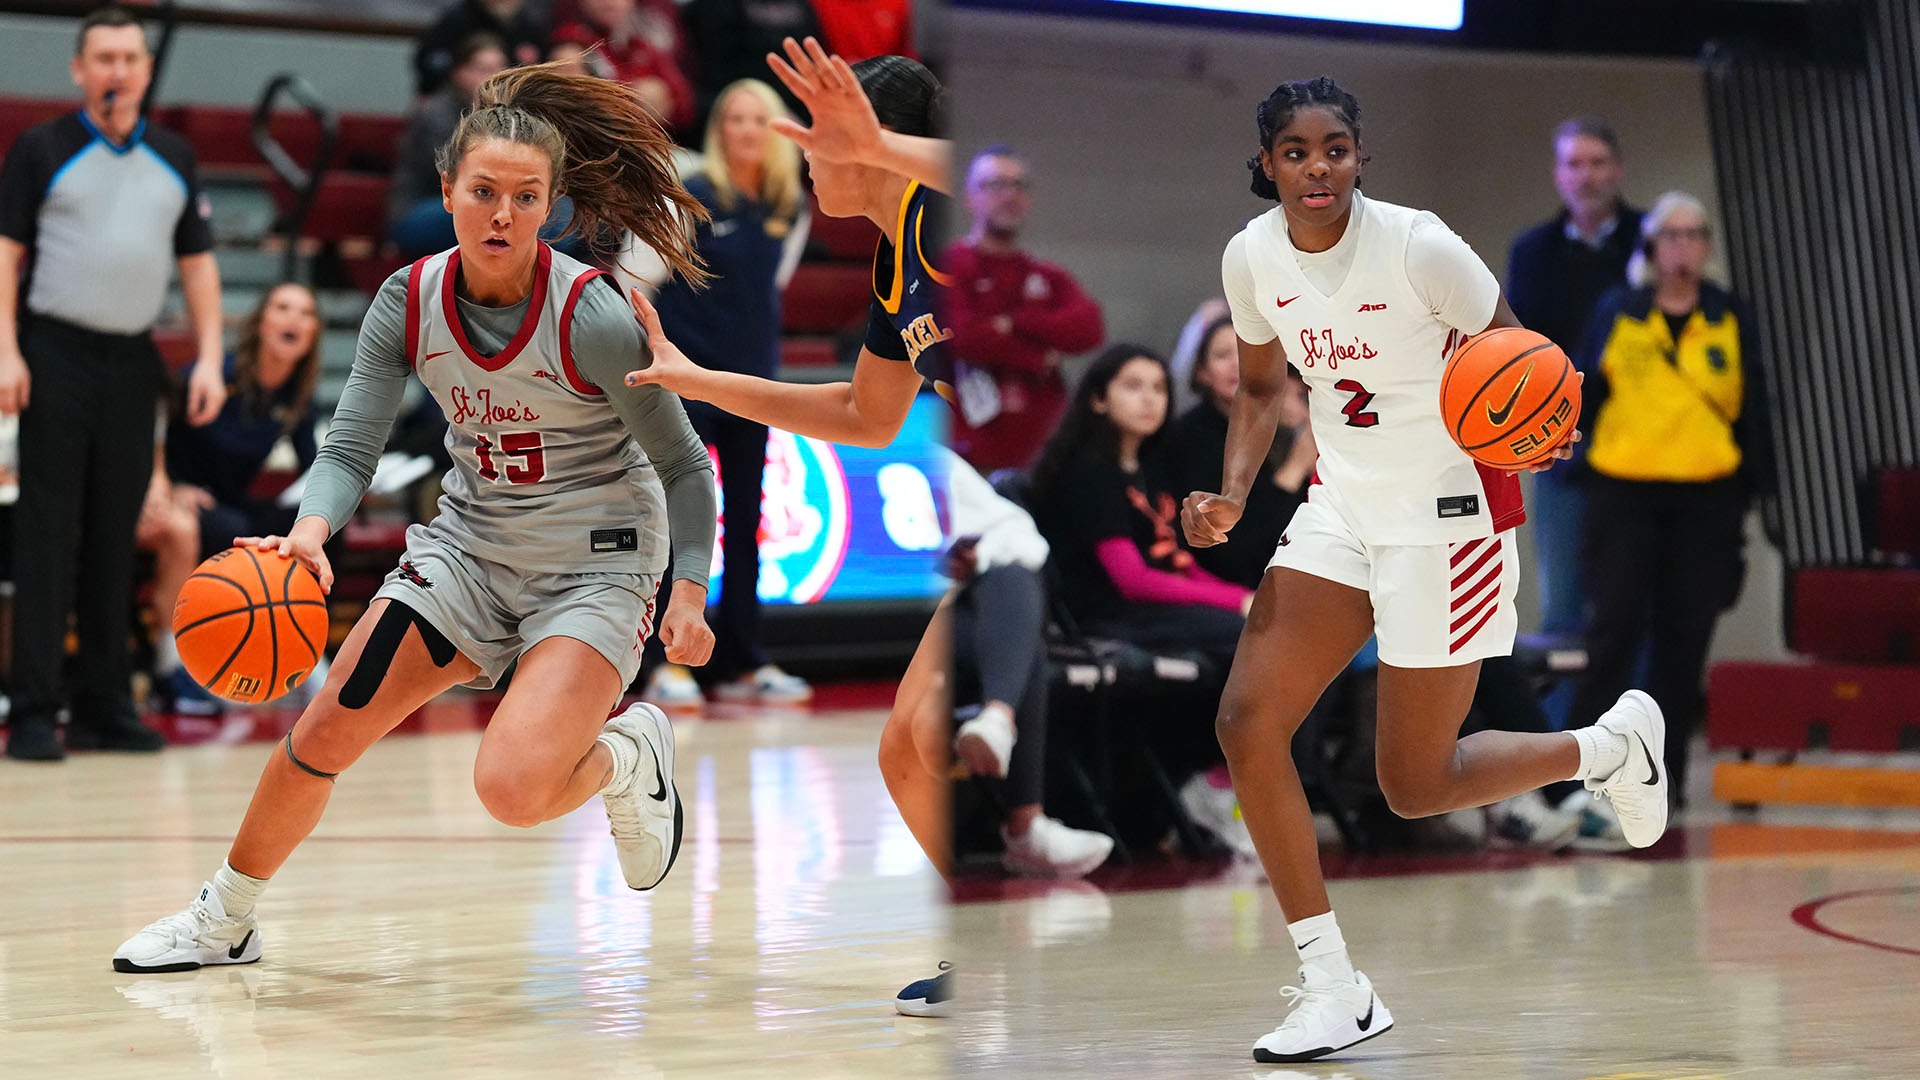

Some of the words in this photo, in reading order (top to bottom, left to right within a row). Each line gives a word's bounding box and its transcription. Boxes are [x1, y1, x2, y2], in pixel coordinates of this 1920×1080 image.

[1358, 303, 1387, 312] A10
[1334, 378, 1379, 428] 2
[474, 431, 548, 485] 15
[1466, 501, 1475, 509] M
[622, 535, 632, 544] M
